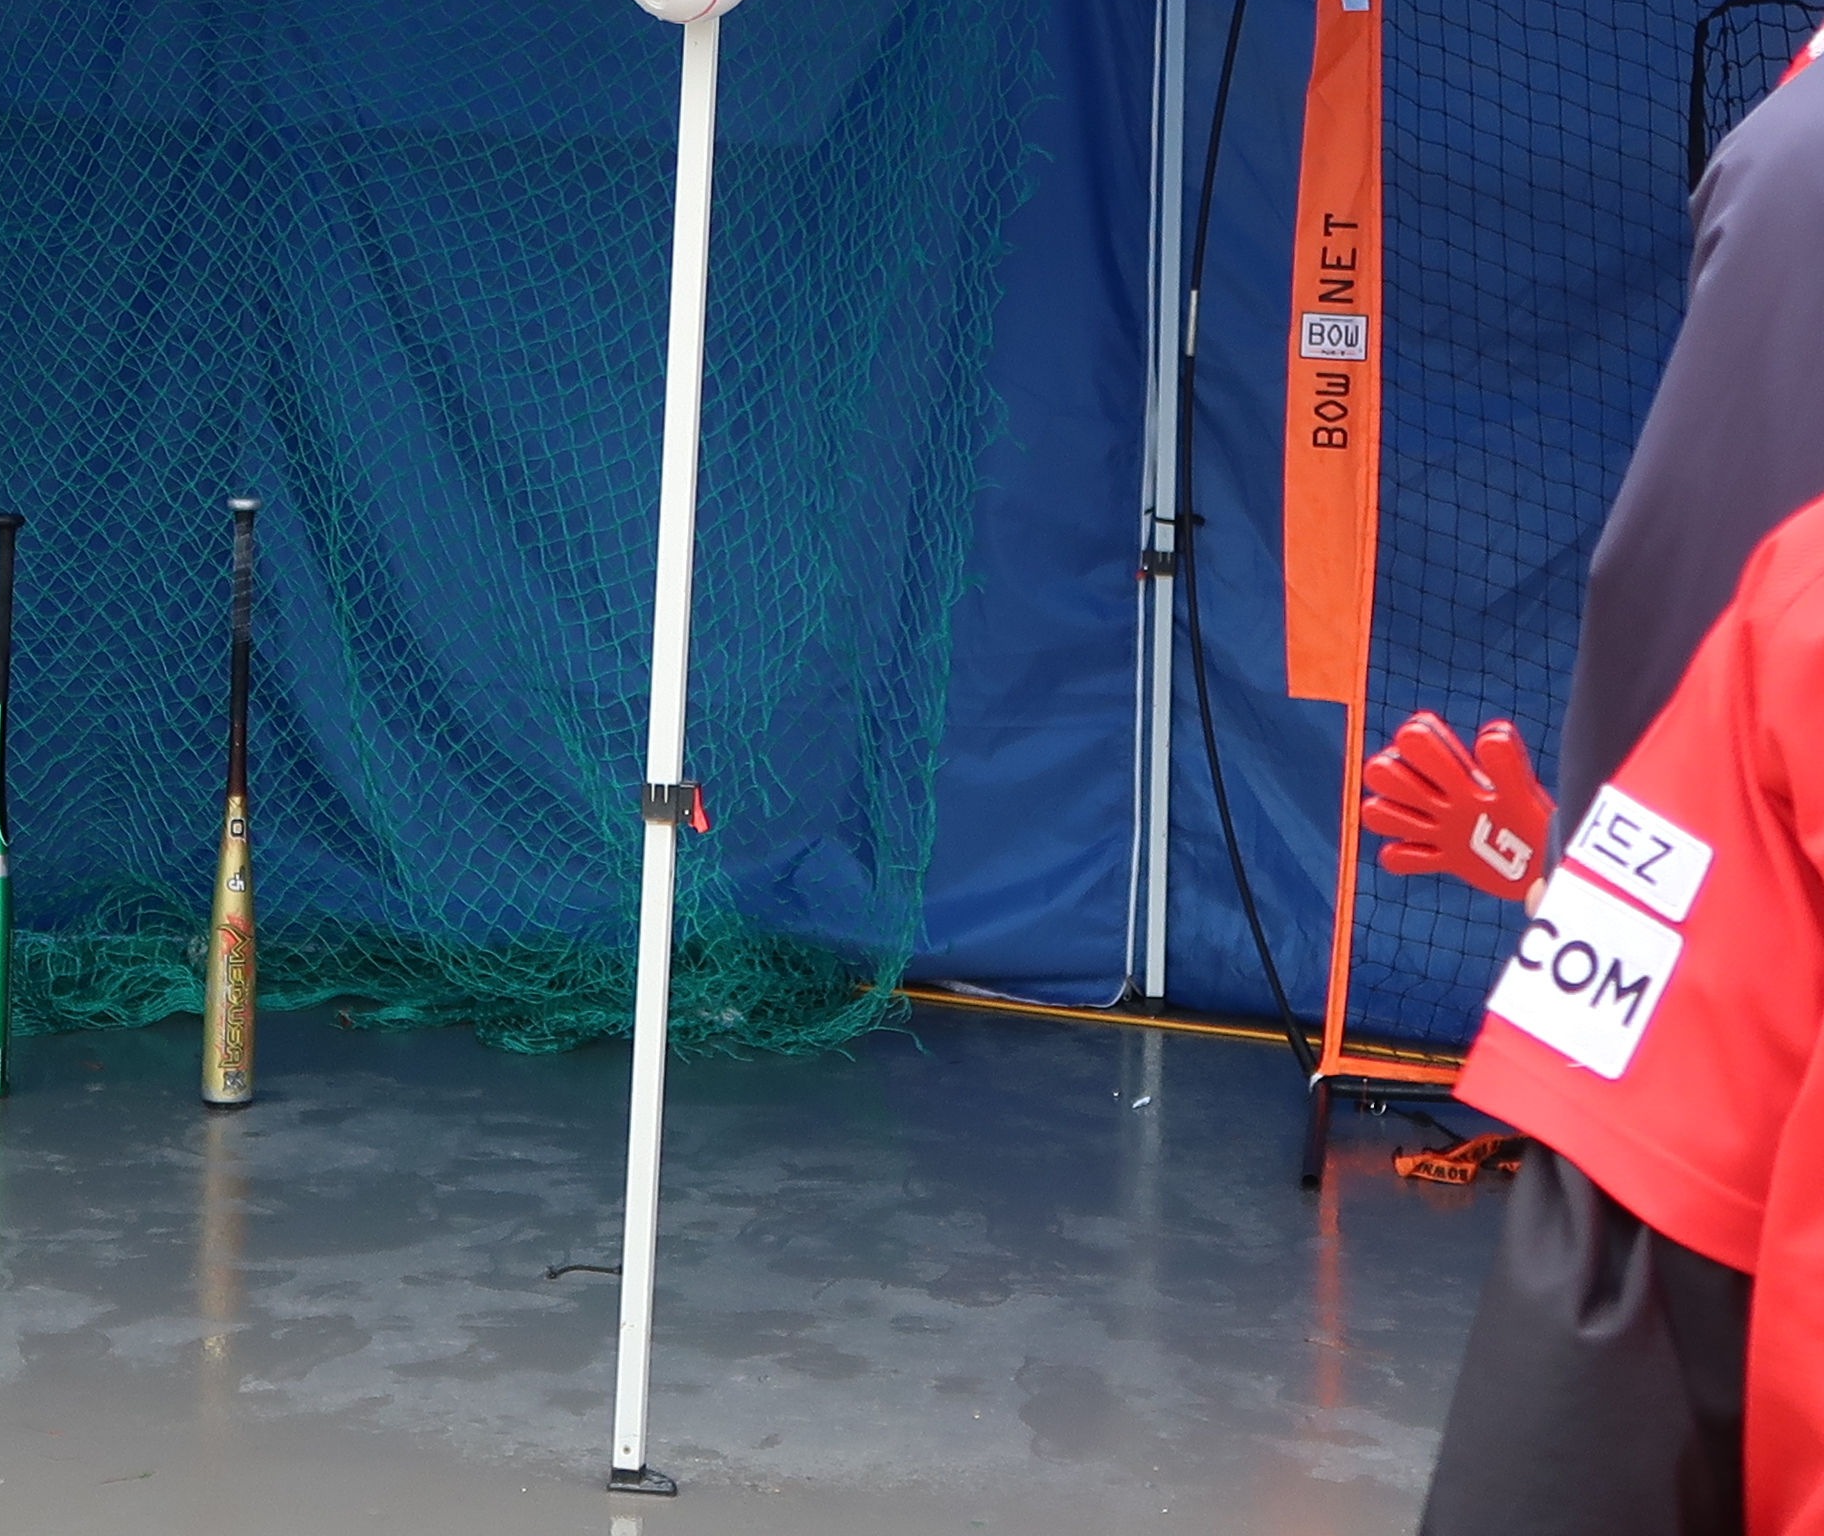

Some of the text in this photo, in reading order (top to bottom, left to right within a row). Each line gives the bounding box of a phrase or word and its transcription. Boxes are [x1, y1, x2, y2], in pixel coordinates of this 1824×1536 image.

[1318, 212, 1360, 304] NET
[1309, 322, 1359, 347] BOW
[1312, 373, 1352, 450] BOW
[1517, 919, 1651, 1026] COM
